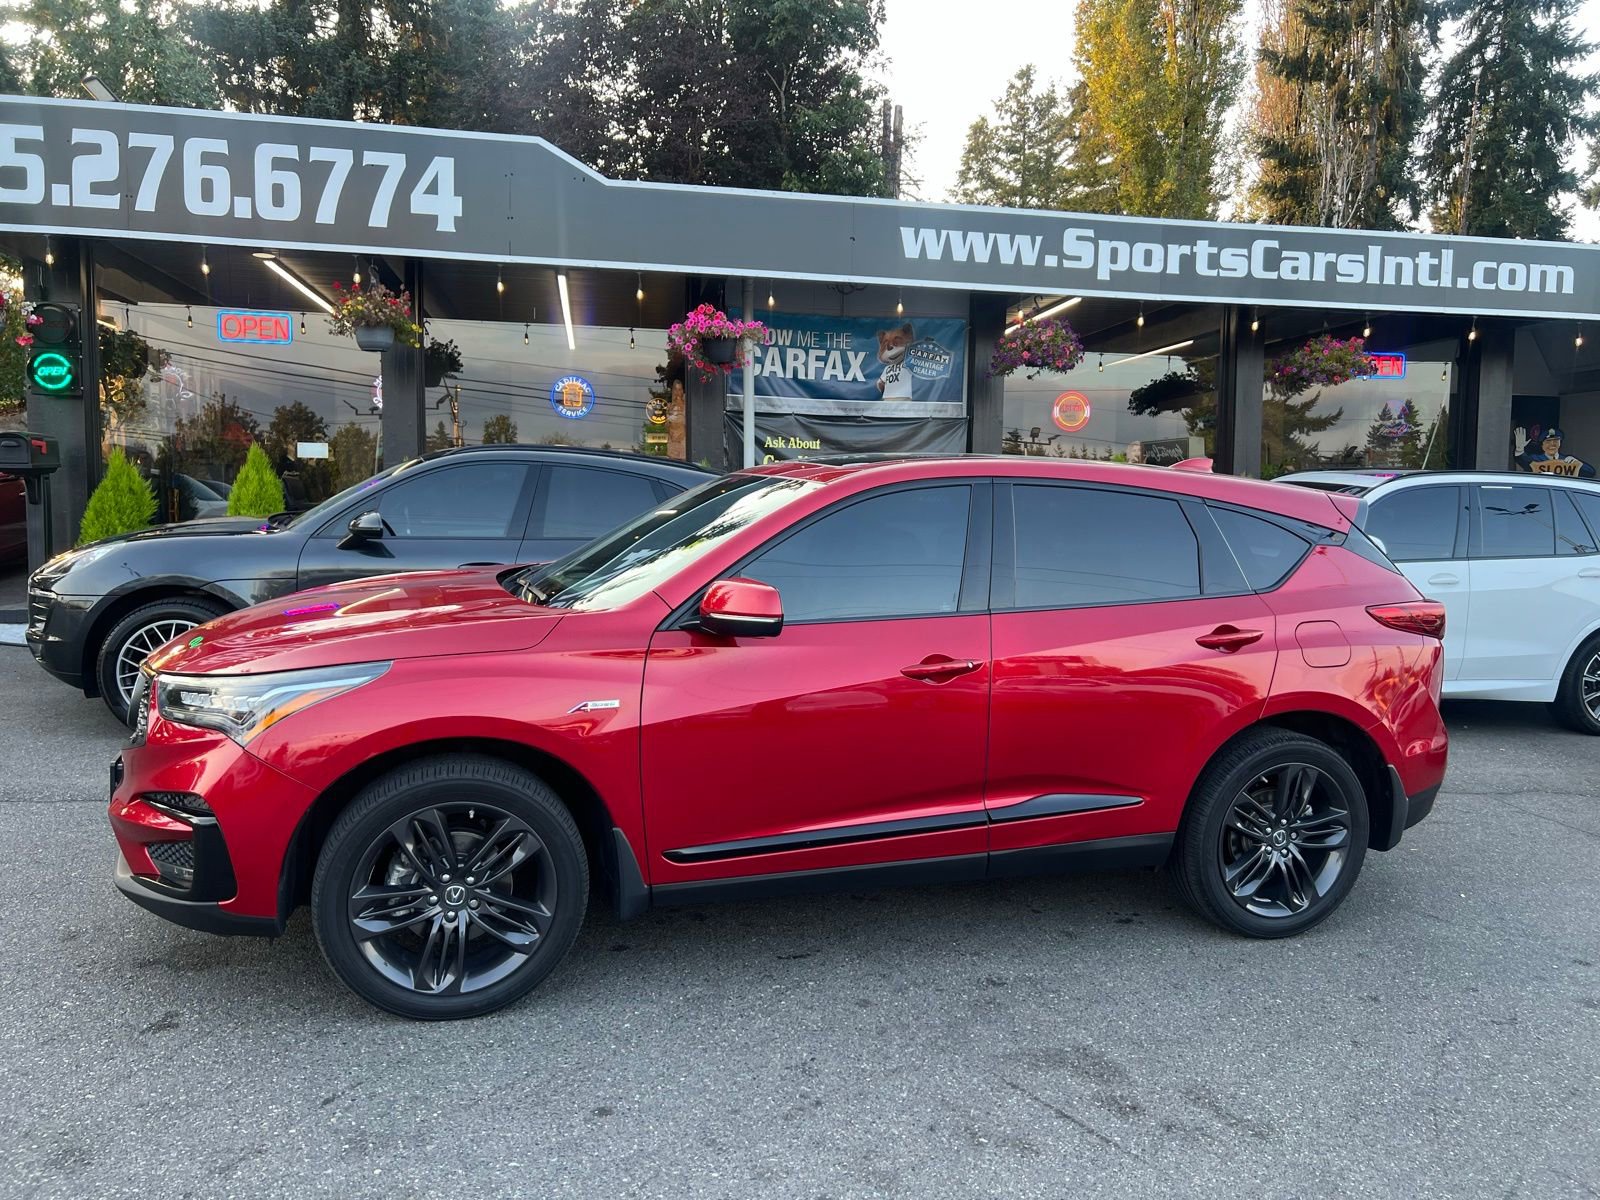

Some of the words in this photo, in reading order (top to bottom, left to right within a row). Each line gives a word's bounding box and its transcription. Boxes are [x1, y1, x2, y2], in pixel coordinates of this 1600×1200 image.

[0, 123, 463, 232] 5.276.6774
[900, 226, 1575, 295] www.SportsCarsIntl.com
[222, 315, 289, 340] OPEN
[754, 328, 793, 346] OW
[797, 330, 820, 348] ME
[824, 332, 852, 350] THE
[910, 349, 950, 364] CARFAX
[37, 366, 68, 376] OPEN
[910, 358, 944, 371] ADVANTAGE
[913, 366, 937, 377] DEALER
[1371, 356, 1403, 376] EN
[558, 405, 588, 417] SERVICE
[764, 436, 786, 449] Ask
[787, 437, 821, 450] About
[1538, 465, 1577, 476] SLOW
